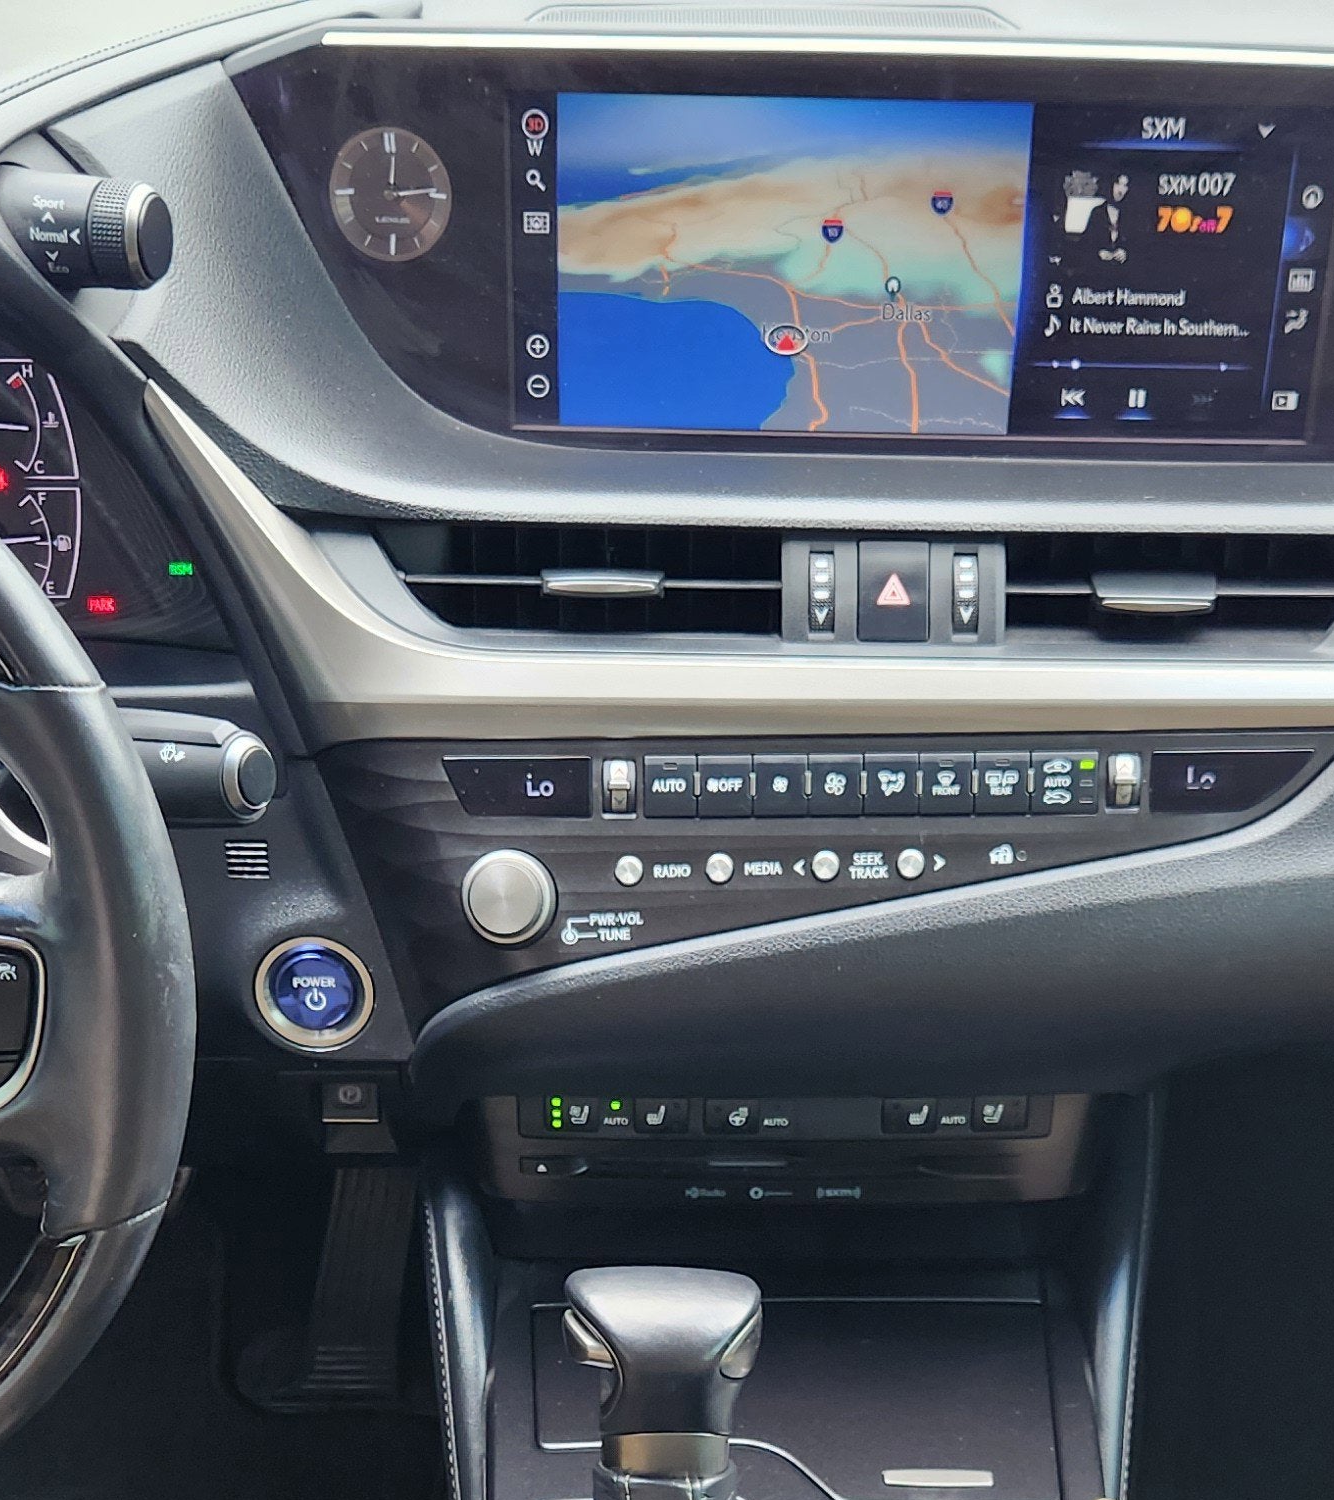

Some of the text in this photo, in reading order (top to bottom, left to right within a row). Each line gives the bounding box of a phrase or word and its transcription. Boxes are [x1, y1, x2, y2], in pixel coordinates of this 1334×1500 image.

[1141, 116, 1187, 140] SXM
[526, 139, 544, 157] W
[1158, 171, 1237, 197] SXM 007
[32, 194, 66, 211] Sport
[29, 226, 69, 244] Normal
[1071, 286, 1187, 307] Albert Hammond
[881, 303, 931, 322] Dallas
[1083, 316, 1125, 335] Never
[1126, 316, 1162, 335] Rains
[21, 364, 34, 379] H
[33, 460, 46, 475] C
[37, 492, 47, 506] F
[45, 581, 56, 596] E
[88, 597, 116, 613] PARK
[651, 778, 687, 793] AUTO
[718, 778, 743, 792] OFF
[1043, 775, 1072, 789] AUTO
[932, 785, 961, 796] FRONT
[852, 851, 885, 866] SEEK
[652, 864, 692, 879] RADIO
[743, 861, 783, 877] MEDIA
[848, 864, 889, 880] TRACK
[596, 927, 632, 942] TUNE
[291, 976, 337, 990] POWER
[603, 1116, 629, 1127] AUTO
[762, 1117, 790, 1127] AUTO
[940, 1115, 967, 1125] AUTO
